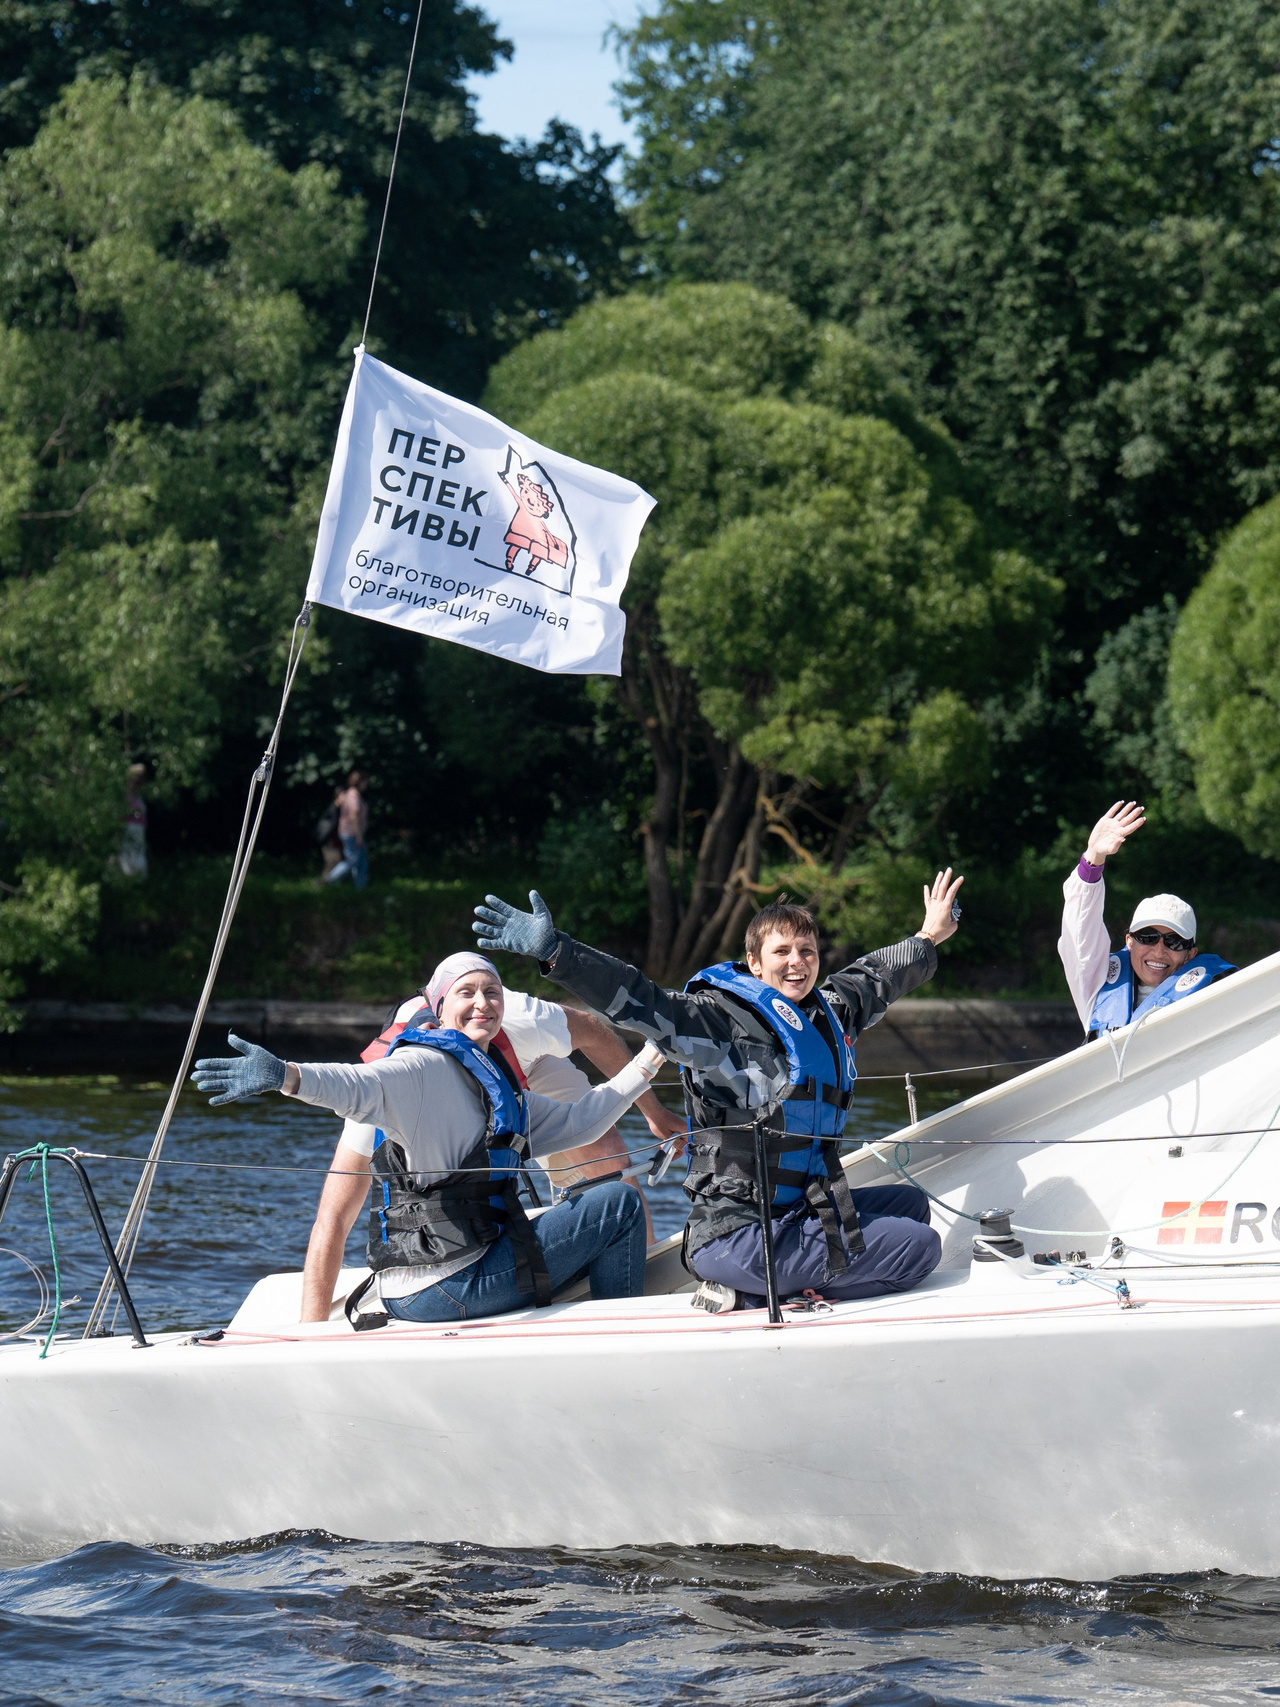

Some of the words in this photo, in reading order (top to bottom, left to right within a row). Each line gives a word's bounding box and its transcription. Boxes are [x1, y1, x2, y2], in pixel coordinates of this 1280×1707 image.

[387, 427, 466, 470] ПЕР
[379, 465, 488, 517] СПЕК
[373, 496, 481, 552] ТИВЫ
[348, 575, 490, 626] организация
[355, 549, 570, 631] благотворительная
